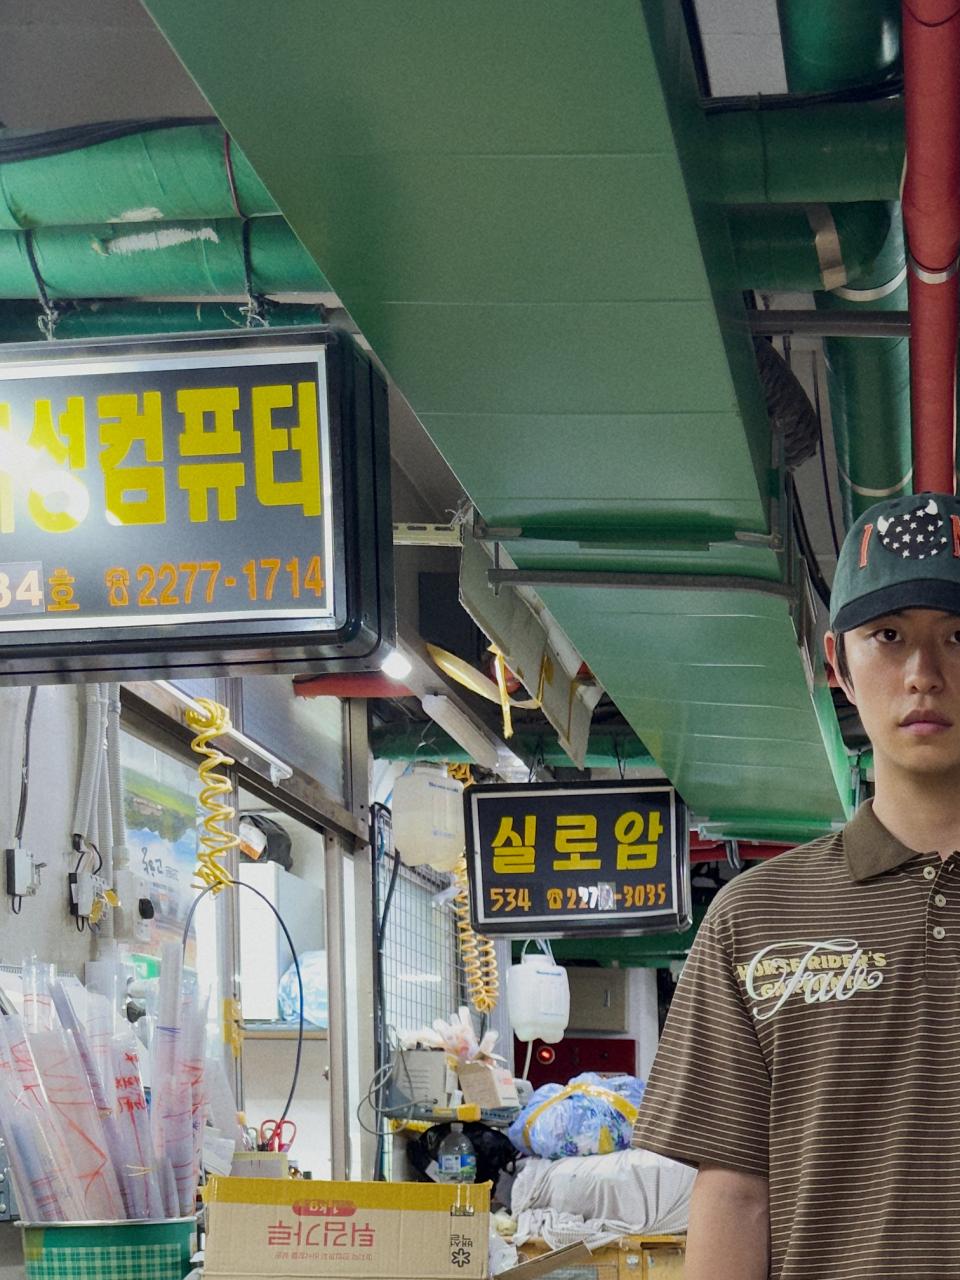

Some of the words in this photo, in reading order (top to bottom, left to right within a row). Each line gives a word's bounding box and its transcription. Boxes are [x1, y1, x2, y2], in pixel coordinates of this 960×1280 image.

[0, 382, 322, 533] 성컴퓨터
[137, 556, 324, 606] 2277-1714
[491, 811, 664, 874] 실로암
[490, 888, 532, 912] 534
[267, 1221, 375, 1247] 튀김가루
